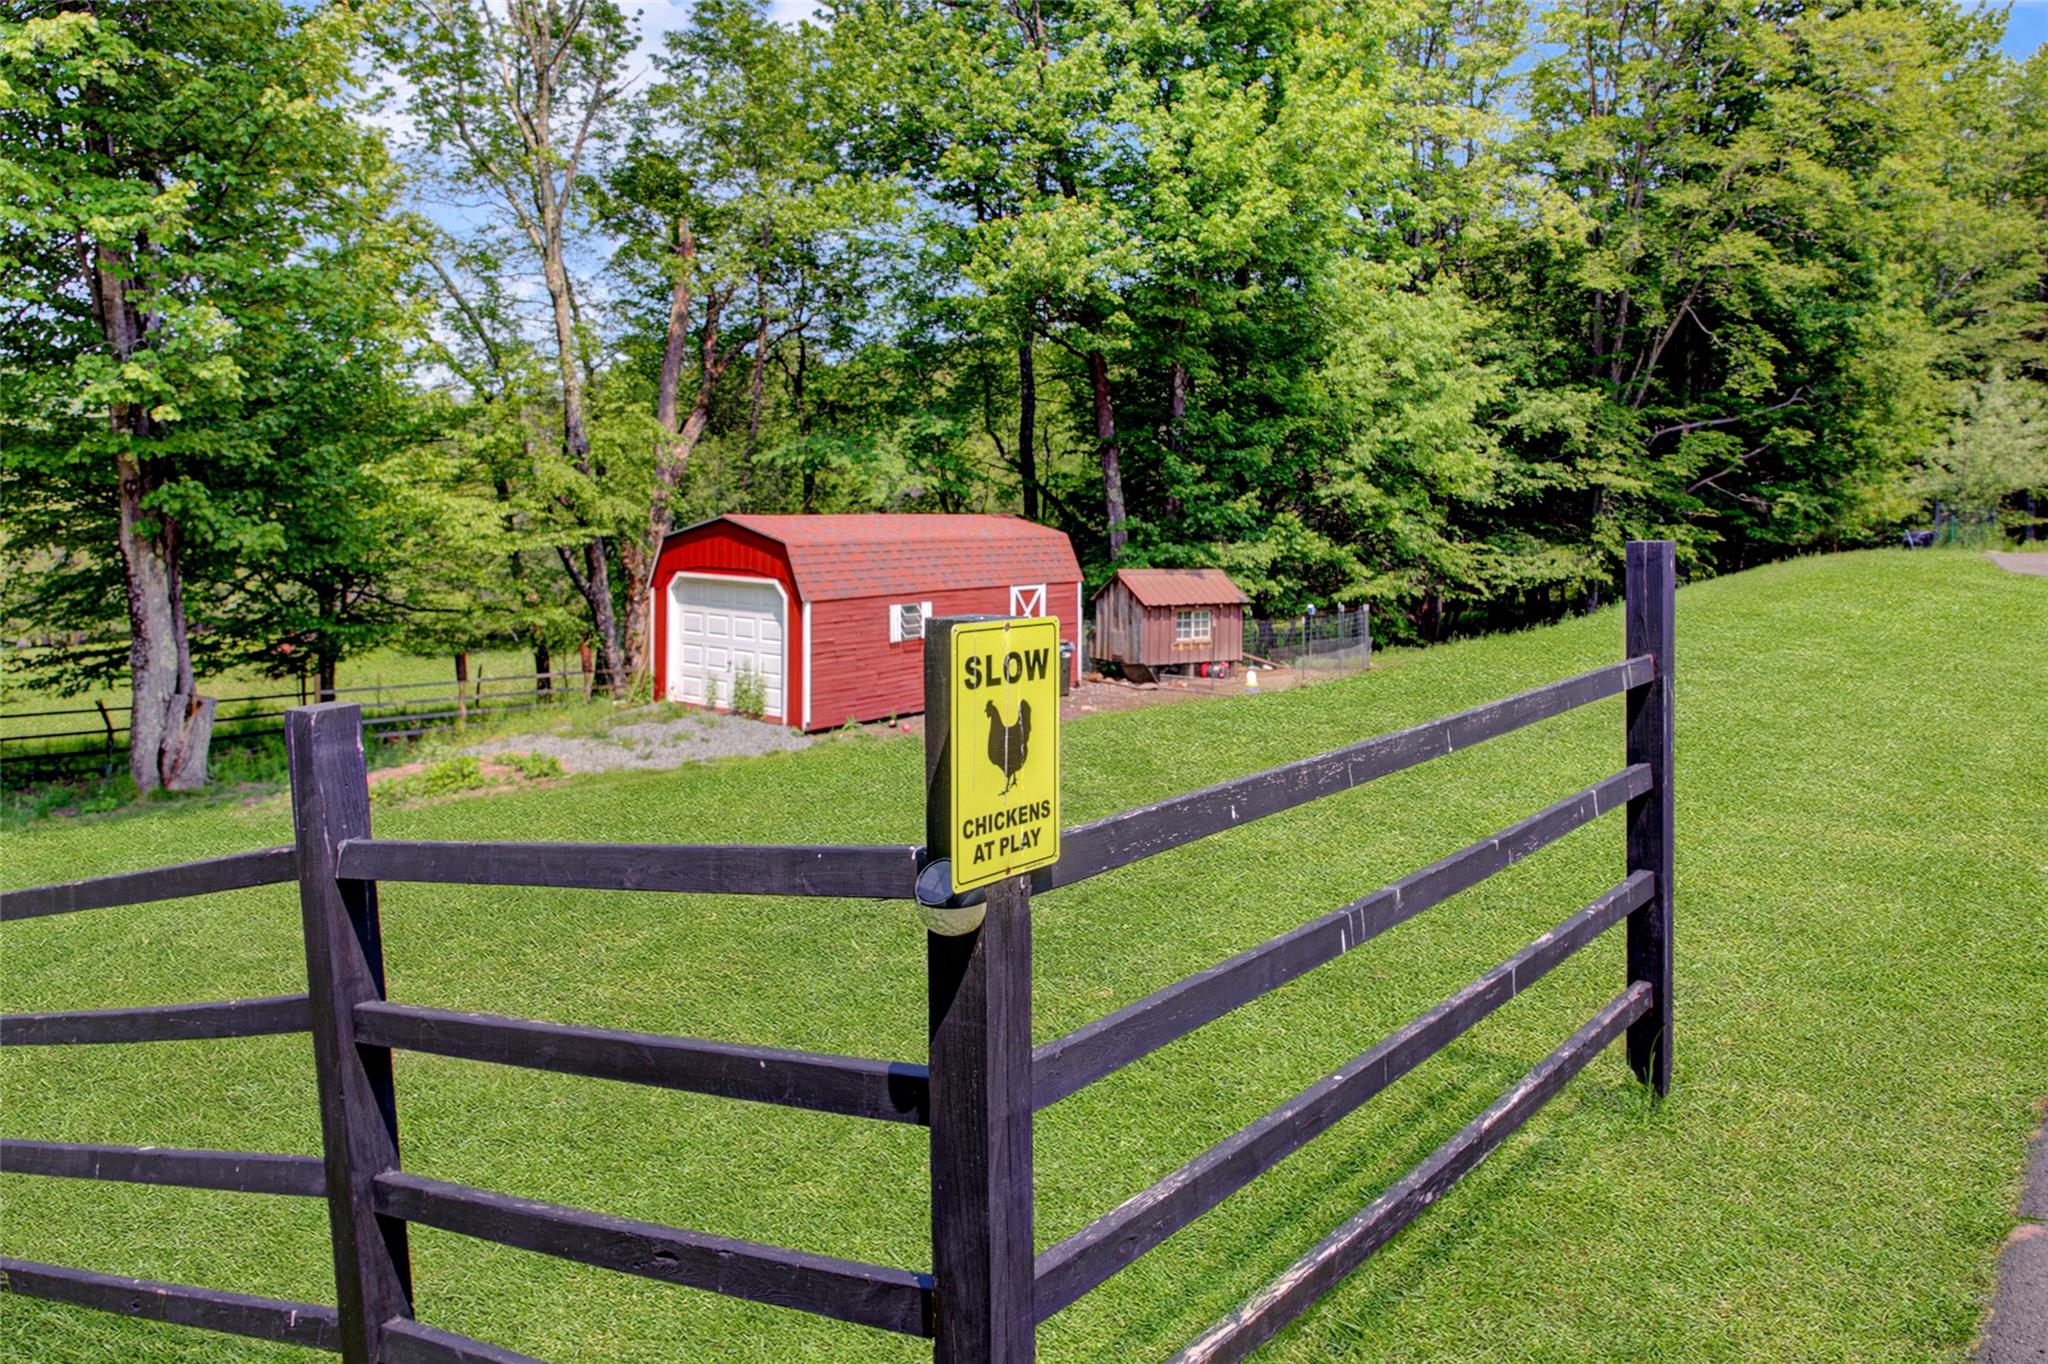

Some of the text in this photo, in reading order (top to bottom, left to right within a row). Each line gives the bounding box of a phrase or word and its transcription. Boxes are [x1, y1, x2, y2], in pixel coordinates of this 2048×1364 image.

[964, 648, 1049, 690] SLOW
[963, 800, 1050, 839] CHICKENS
[973, 827, 1042, 865] AT PLAY
